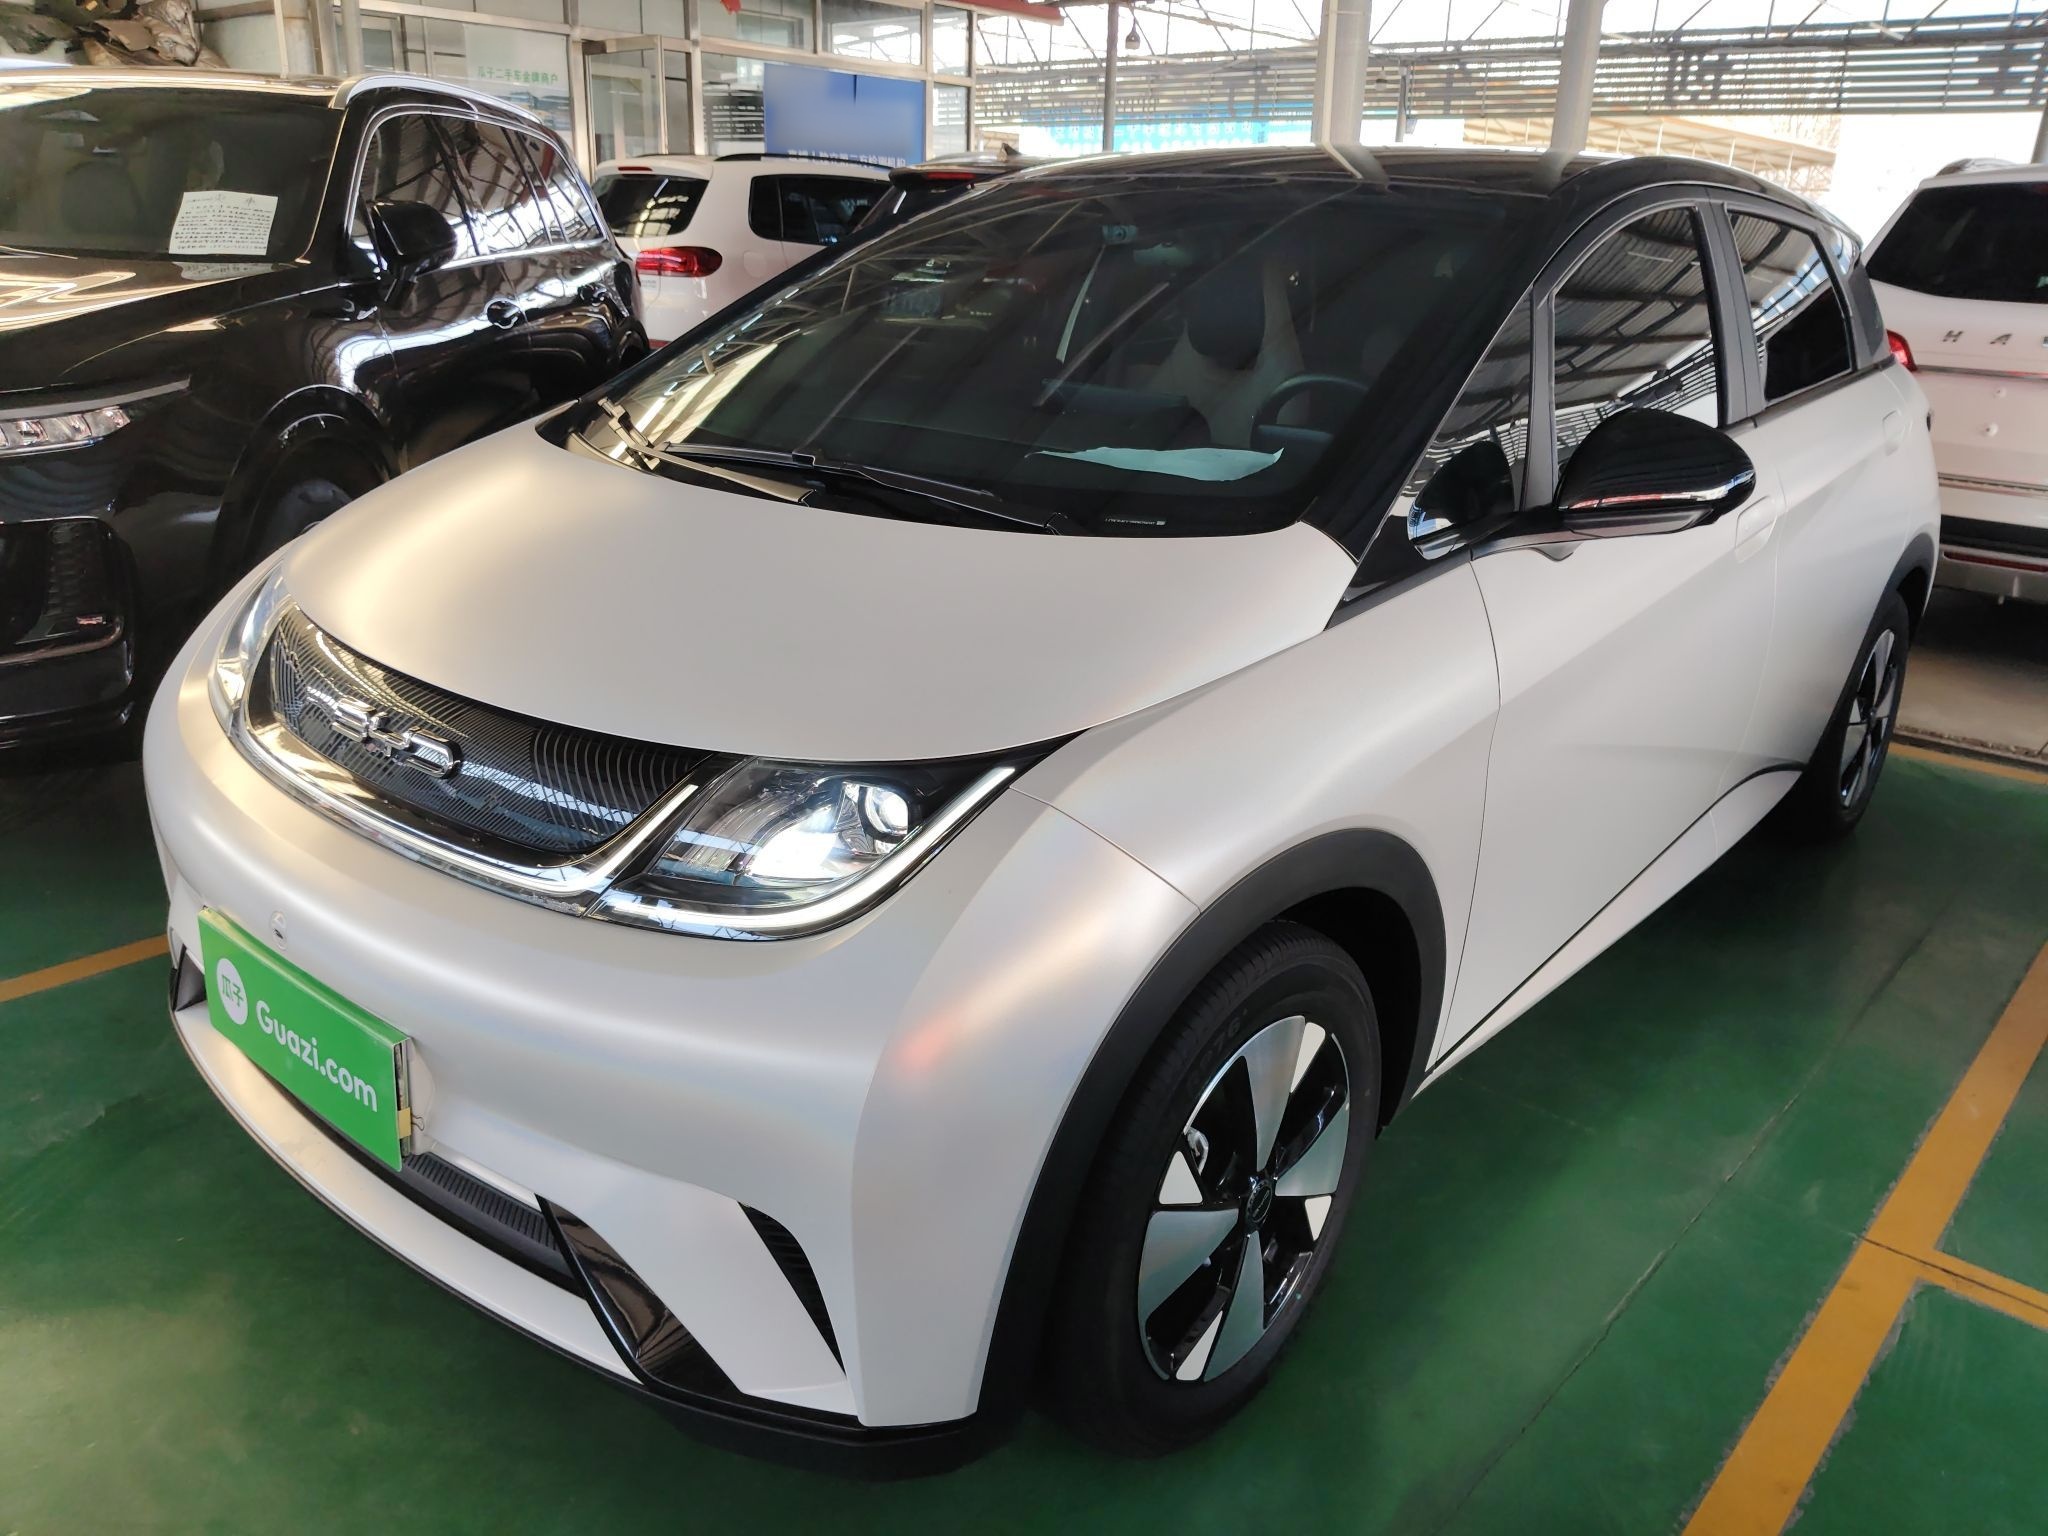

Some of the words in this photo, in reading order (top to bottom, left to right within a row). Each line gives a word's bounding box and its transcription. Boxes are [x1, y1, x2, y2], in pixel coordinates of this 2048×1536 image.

[1942, 330, 2048, 347] HA
[221, 973, 245, 1008] 瓜子
[255, 1000, 378, 1113] Guazi.com
